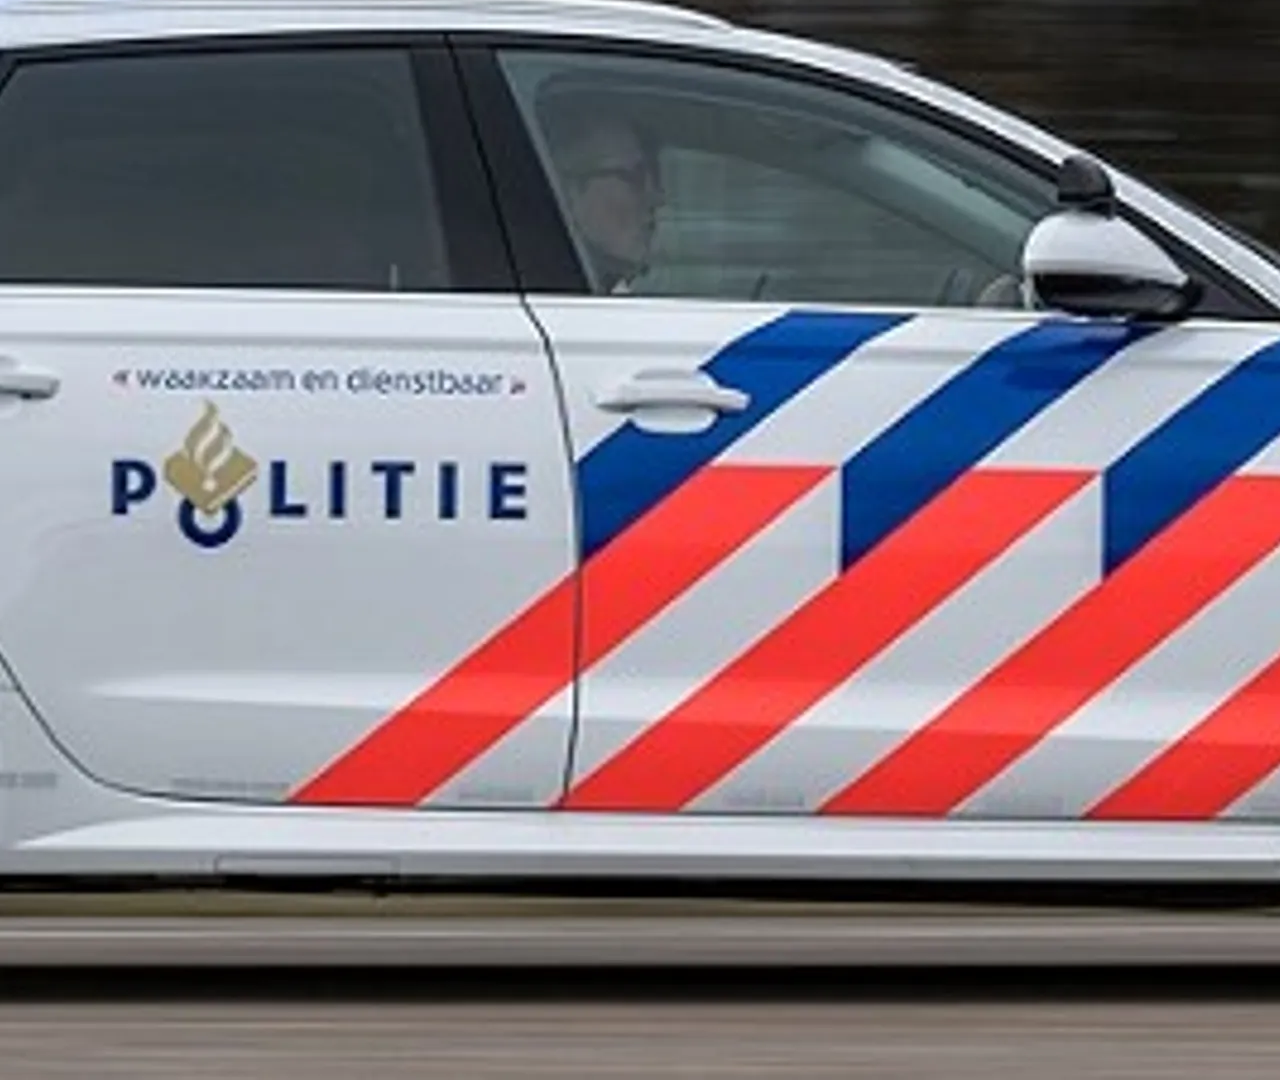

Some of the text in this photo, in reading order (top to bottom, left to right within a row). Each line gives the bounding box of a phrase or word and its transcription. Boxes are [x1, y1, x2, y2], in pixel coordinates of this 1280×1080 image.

[136, 367, 503, 396] waakzaam en dienstbaar
[111, 460, 528, 548] POLITIE
